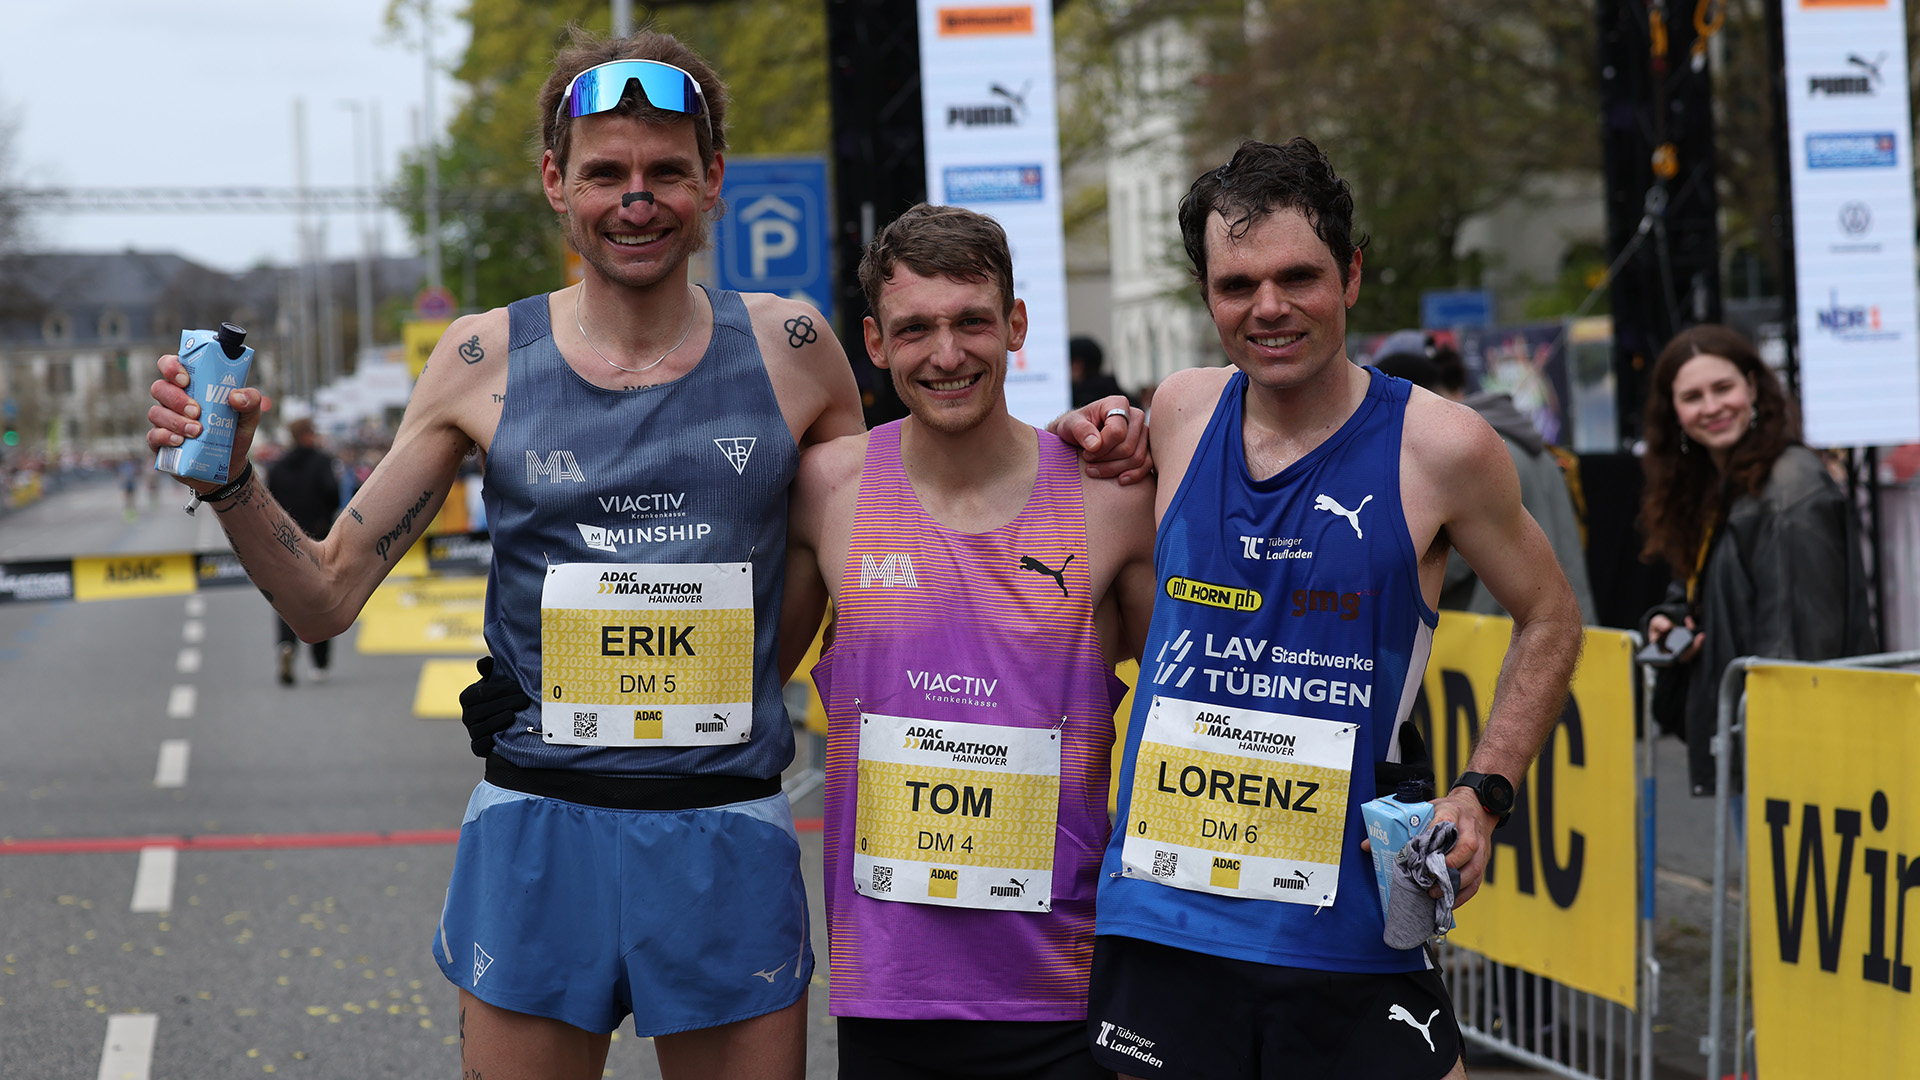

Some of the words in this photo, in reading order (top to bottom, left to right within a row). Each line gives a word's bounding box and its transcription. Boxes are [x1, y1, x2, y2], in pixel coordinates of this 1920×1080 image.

[751, 217, 798, 281] P
[205, 383, 234, 405] VIL
[207, 412, 234, 429] Carat
[598, 492, 685, 513] VIACTIV
[631, 511, 686, 520] Krankenkasse
[606, 523, 712, 545] MINSHIP
[1268, 537, 1302, 548] Tübinger
[1266, 550, 1313, 560] Laufladen
[599, 571, 638, 582] ADAC
[614, 583, 703, 595] MARATHON
[1190, 585, 1231, 605] HORN
[648, 595, 703, 604] HANNOVER
[601, 626, 697, 657] ERIK
[1205, 633, 1268, 662] LAV
[1271, 646, 1374, 672] Stadtwerke
[553, 685, 562, 699] 0
[620, 675, 656, 693] DM
[663, 675, 676, 693] 5
[907, 670, 998, 698] VIACTIV
[1203, 666, 1372, 708] TÜBINGEN
[925, 692, 998, 708] Krankenkasse
[635, 711, 663, 721] ADAC
[1196, 712, 1231, 725] ADAC
[695, 722, 724, 733] PUMA
[905, 726, 944, 740] ADAC
[1207, 725, 1296, 747] MARATHON
[919, 738, 1008, 758] MARATHON
[1238, 741, 1296, 756] HANNOVER
[952, 754, 1008, 766] HANNOVER
[1157, 761, 1320, 813] LORENZ
[1408, 667, 1586, 910] DAC
[905, 780, 994, 819] TOM
[1138, 821, 1147, 835] 0
[1201, 818, 1238, 841] DM
[1244, 825, 1258, 844] 6
[861, 837, 867, 851] 0
[917, 831, 954, 852] DM
[960, 835, 974, 854] 4
[1212, 858, 1241, 871] ADAC
[930, 868, 958, 881] ADAC
[990, 885, 1020, 897] PUMA
[1273, 877, 1304, 890] PUMA
[1116, 1026, 1156, 1048] Tübinger
[1110, 1039, 1163, 1068] Laufladen
